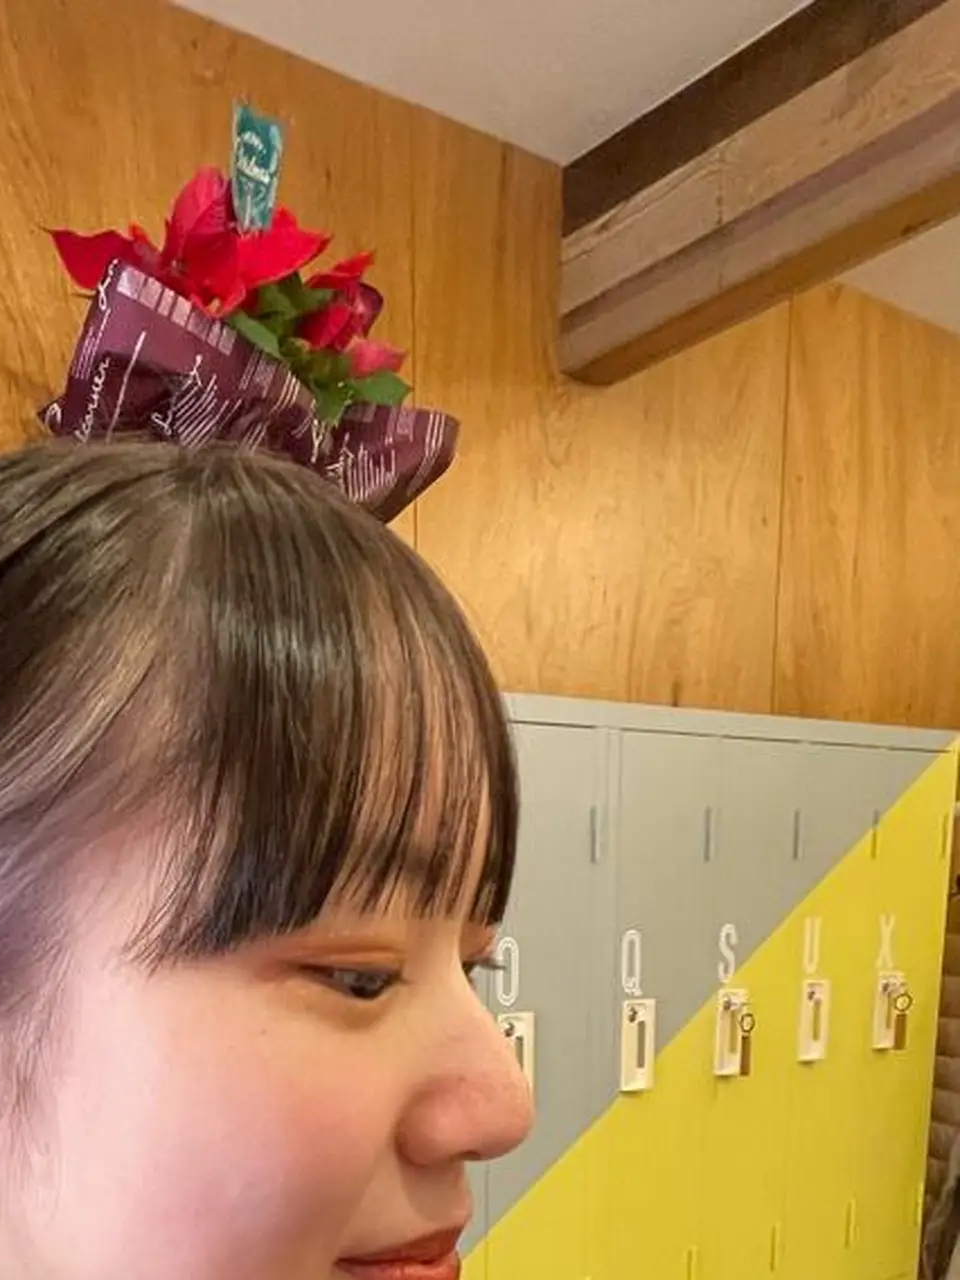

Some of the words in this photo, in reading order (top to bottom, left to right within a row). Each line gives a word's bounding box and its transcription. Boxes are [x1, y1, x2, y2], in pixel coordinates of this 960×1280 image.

[495, 936, 520, 1006] O
[622, 929, 643, 996] Q
[718, 923, 738, 984] S
[802, 916, 821, 974] U
[876, 914, 897, 969] X
